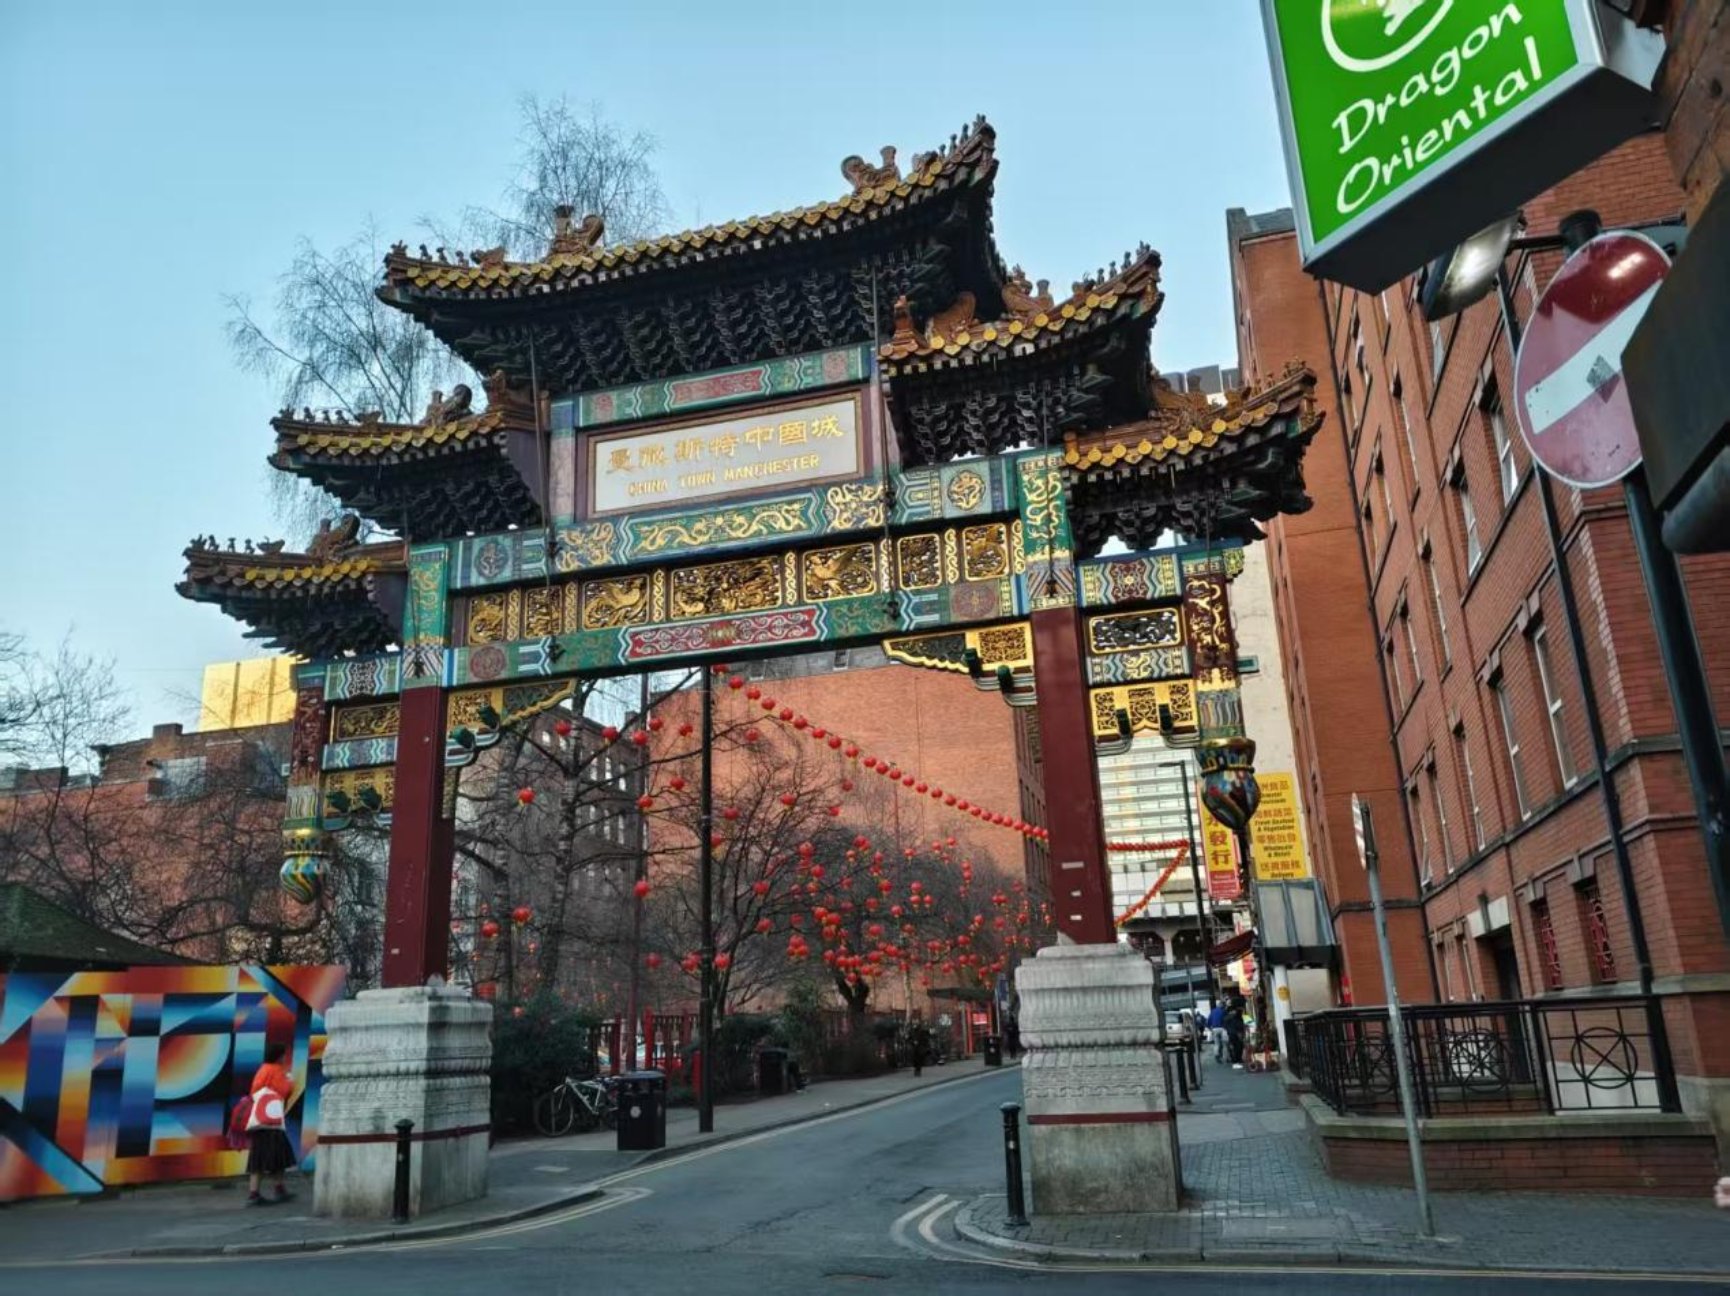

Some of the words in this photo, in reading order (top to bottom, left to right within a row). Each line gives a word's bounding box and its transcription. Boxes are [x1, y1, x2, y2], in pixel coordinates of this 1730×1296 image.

[1331, 3, 1523, 155] Dragon
[1336, 35, 1543, 215] Oriental
[627, 479, 669, 497] CHINA
[680, 470, 716, 488] TOWN
[724, 454, 820, 481] MANCHESTER
